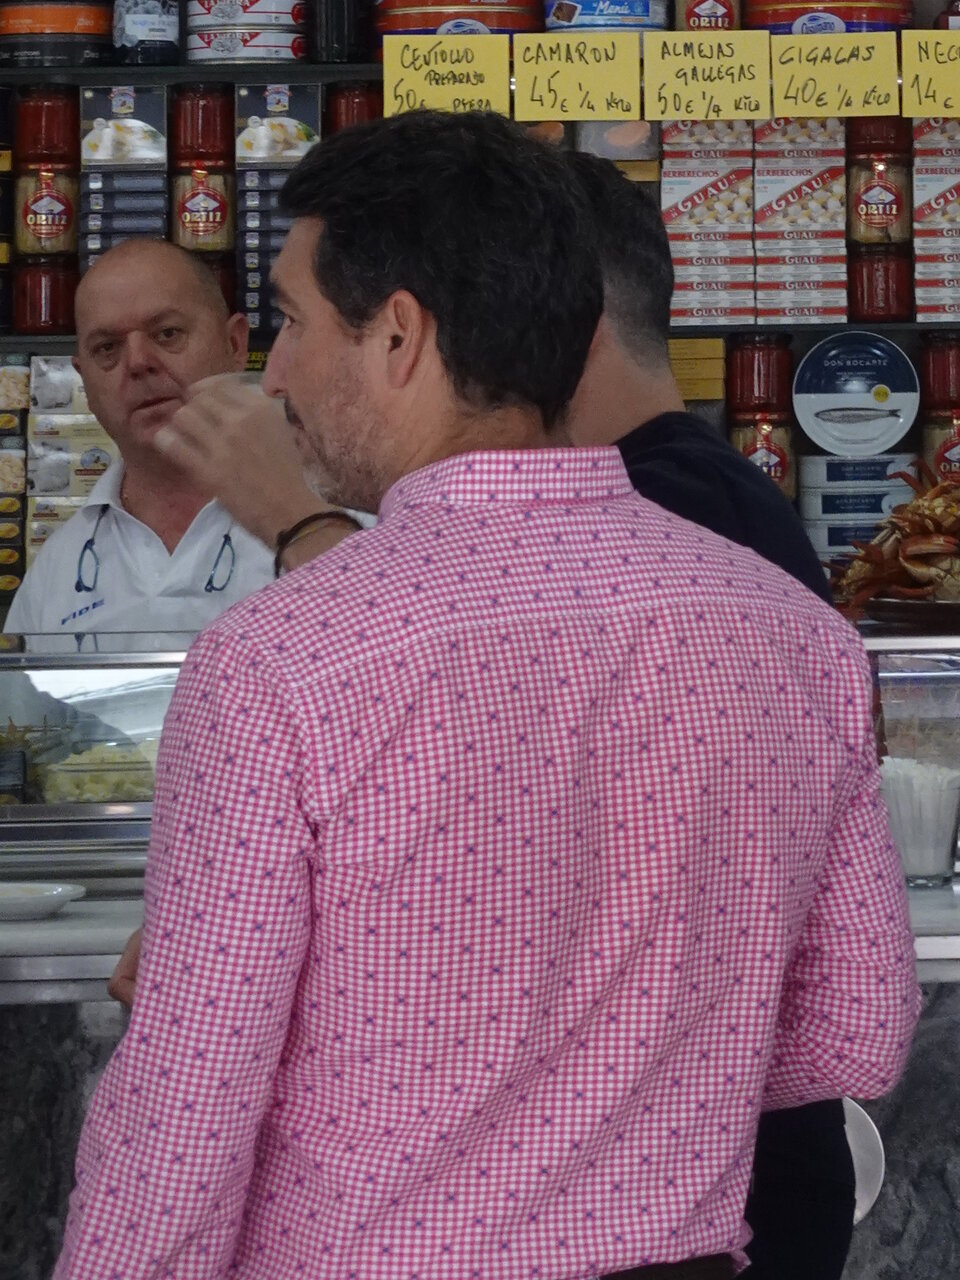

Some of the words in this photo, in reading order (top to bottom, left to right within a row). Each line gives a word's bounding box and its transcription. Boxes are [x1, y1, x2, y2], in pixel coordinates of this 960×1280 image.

[690, 16, 729, 27] ORTIZ
[523, 41, 616, 65] CAMARON
[661, 41, 734, 60] ALMEJAS
[857, 203, 898, 215] ORTIZ
[26, 214, 67, 225] ORTIZ
[182, 212, 223, 223] ORTIZ
